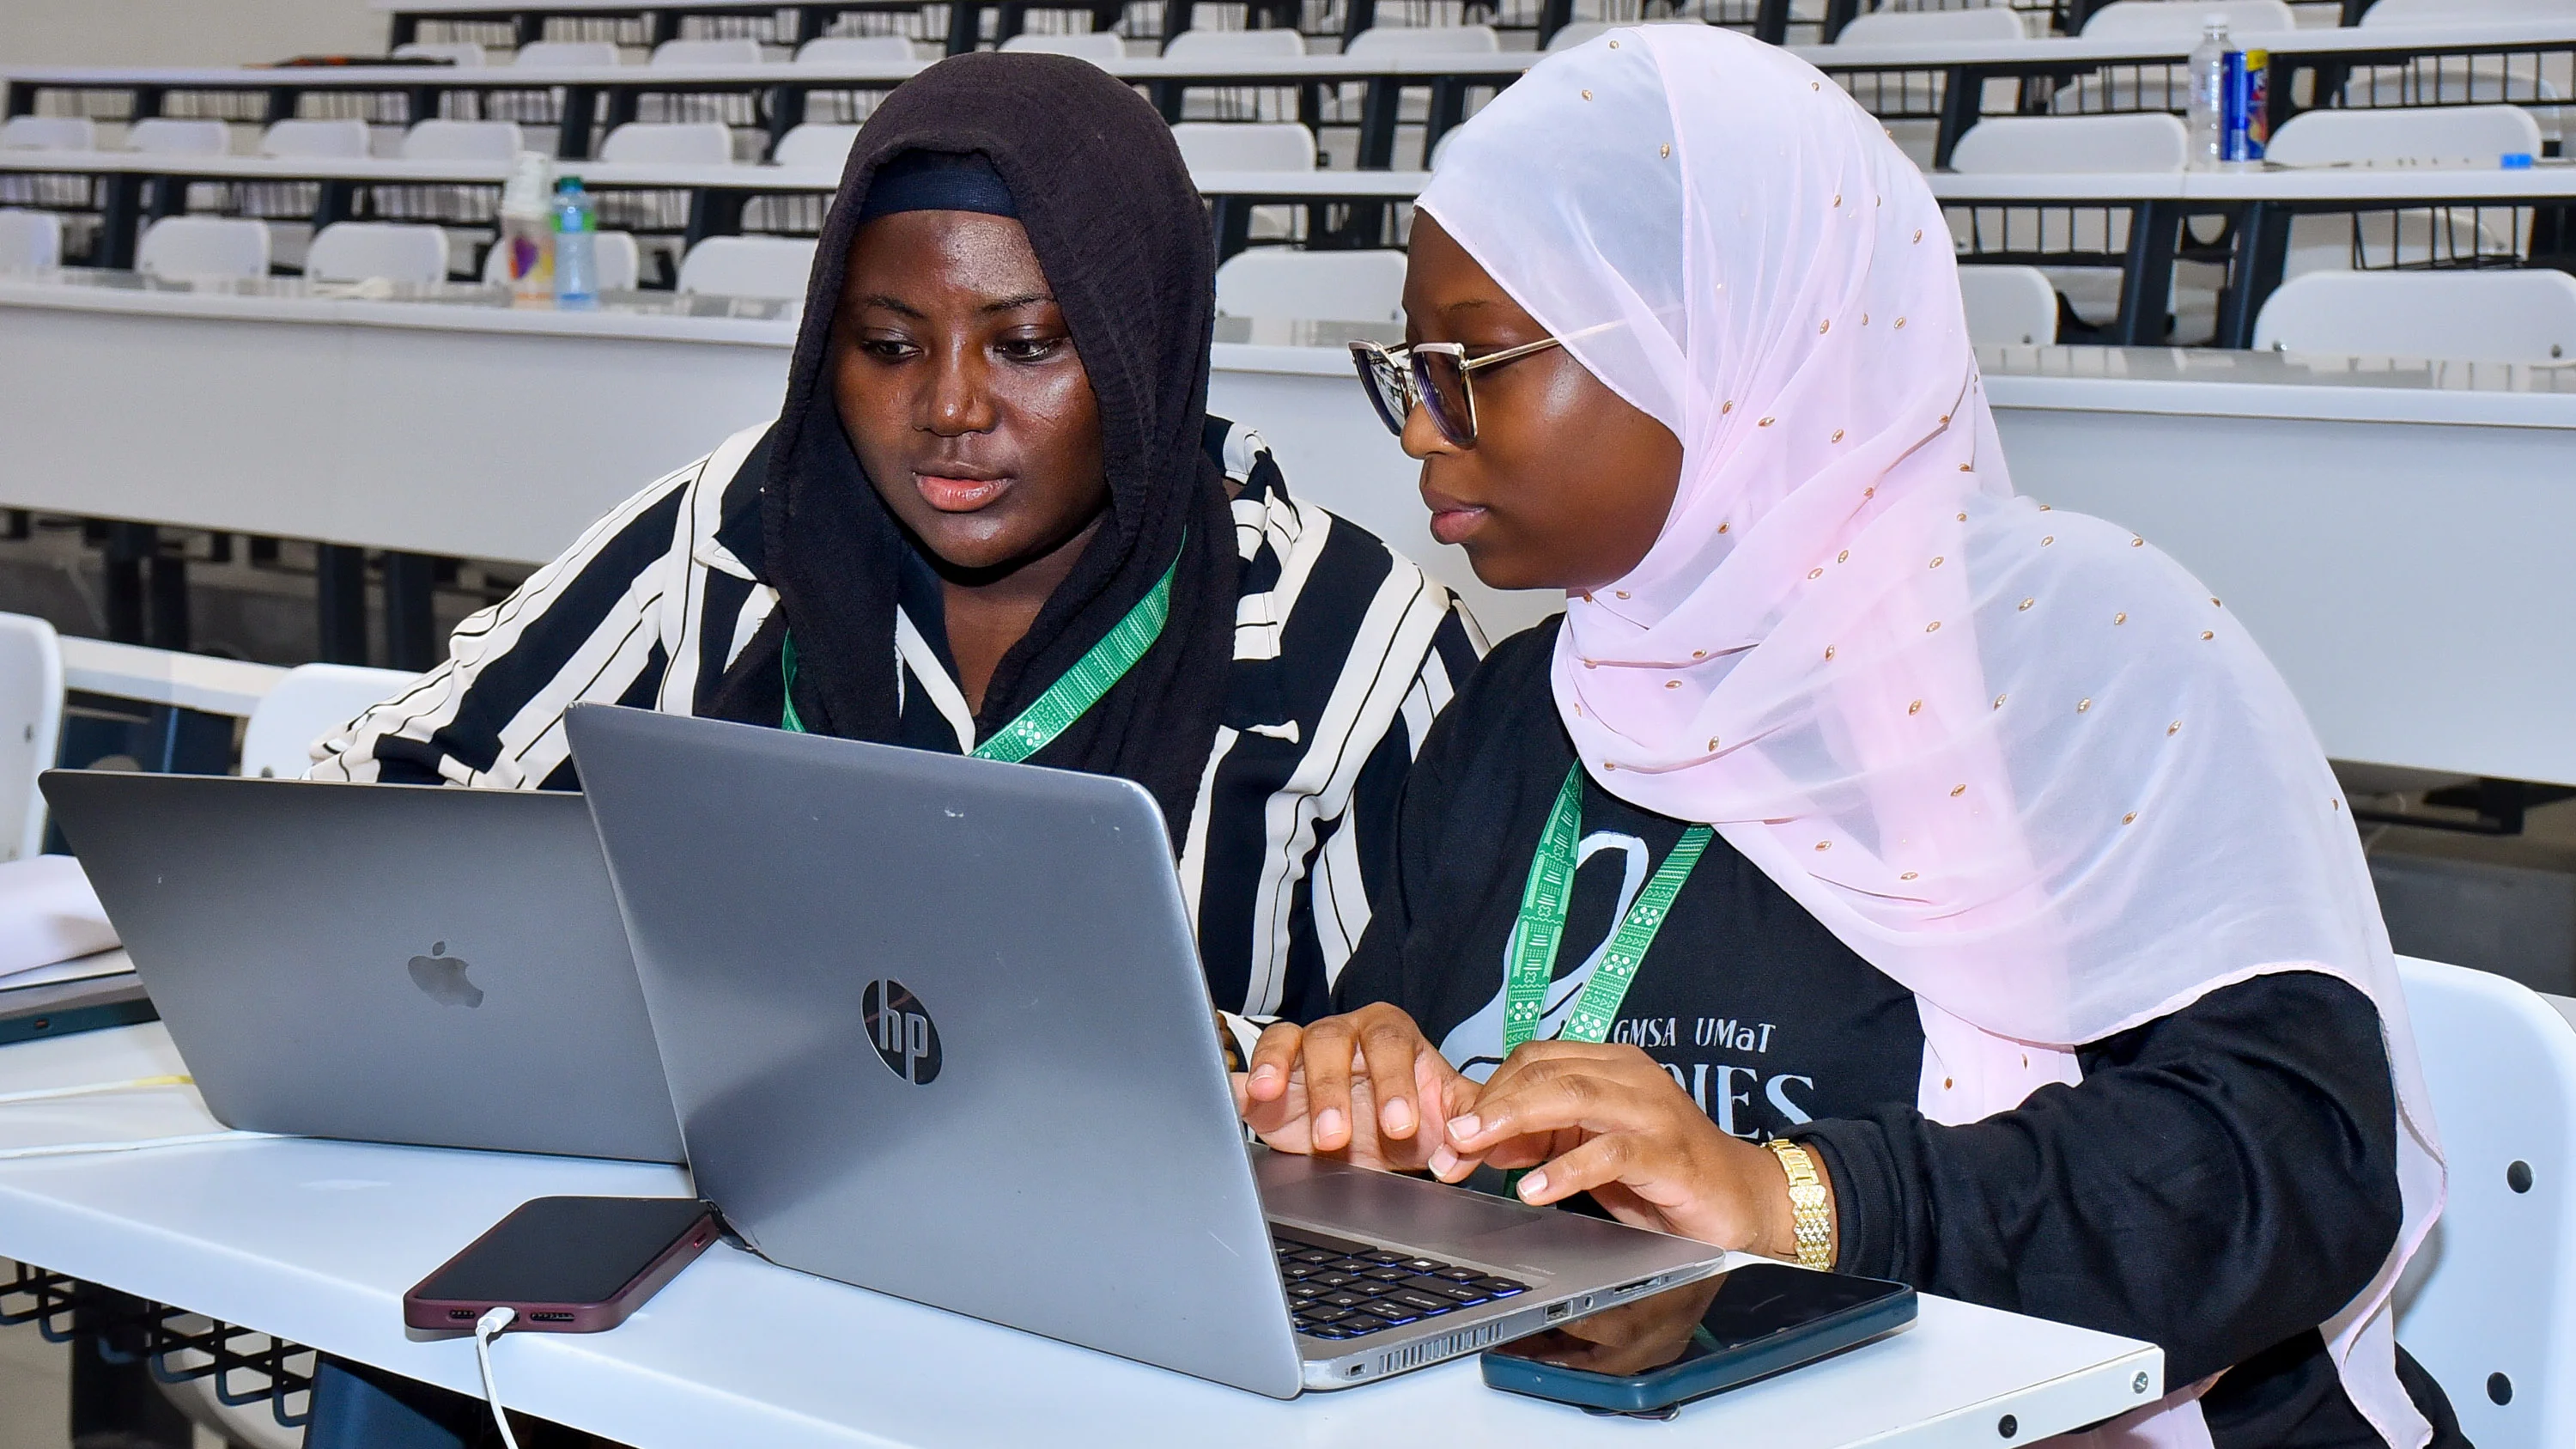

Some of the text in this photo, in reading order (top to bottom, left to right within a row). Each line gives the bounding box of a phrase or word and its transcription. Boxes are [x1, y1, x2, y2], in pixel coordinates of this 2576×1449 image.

[878, 978, 928, 1086] hp
[1613, 1017, 1776, 1053] GMSA UMaT
[1658, 1062, 1814, 1140] IES
